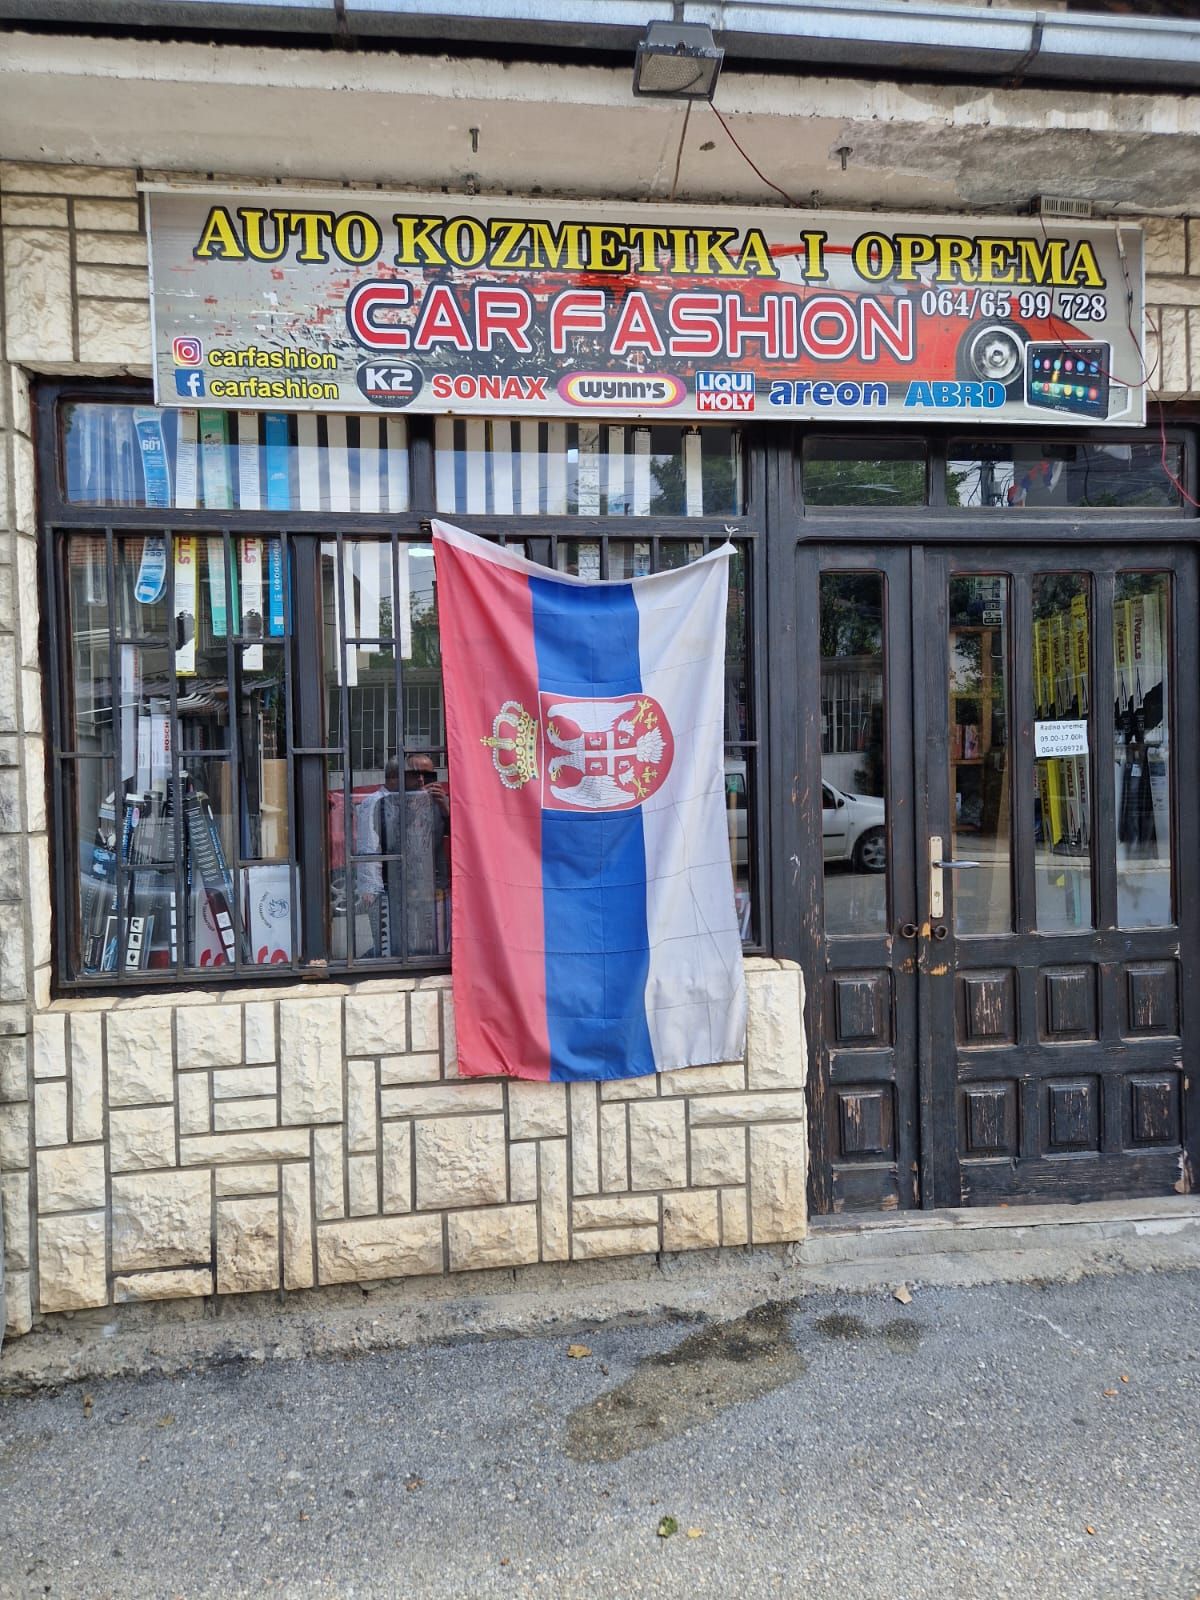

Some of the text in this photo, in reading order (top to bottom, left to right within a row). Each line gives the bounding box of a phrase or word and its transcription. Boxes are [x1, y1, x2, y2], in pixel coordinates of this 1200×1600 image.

[194, 207, 1105, 289] AUTO KOZMETIKA I OPREMA
[920, 290, 1106, 320] 064/65 99 728
[208, 346, 338, 369] carfashion
[209, 376, 339, 399] carfashion
[366, 368, 413, 391] K2
[432, 374, 548, 400] SONAX
[699, 373, 752, 391] LIQUI
[699, 392, 753, 410] MOLY
[769, 380, 888, 407] areon
[904, 381, 1006, 408] ABRO
[142, 440, 161, 451] 601
